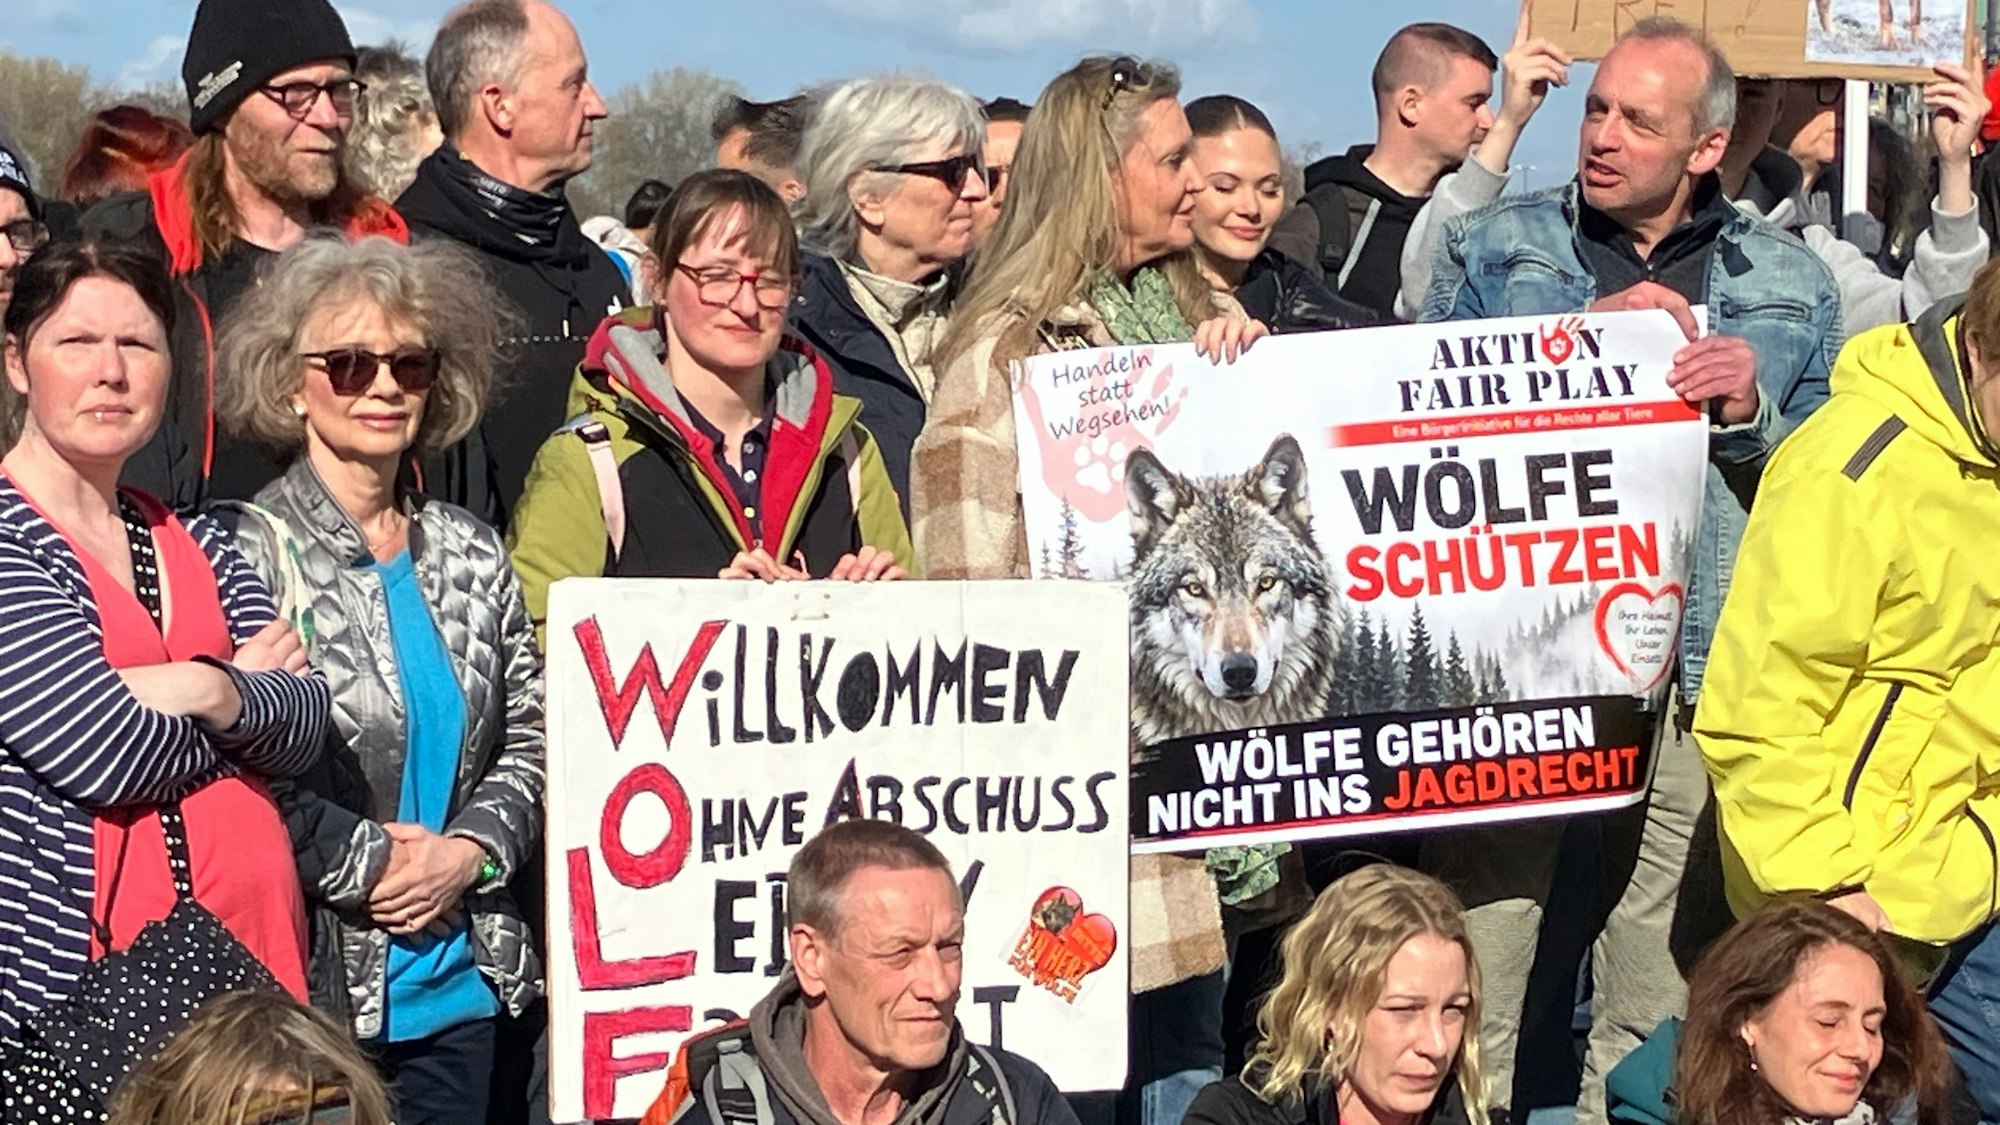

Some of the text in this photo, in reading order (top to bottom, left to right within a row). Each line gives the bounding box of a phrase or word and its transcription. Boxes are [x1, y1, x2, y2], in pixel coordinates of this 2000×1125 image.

[1052, 349, 1153, 387] Handeln
[1398, 364, 1638, 412] FAIR PLAY
[1049, 395, 1171, 440] Wegsehen!
[1078, 379, 1134, 408] statt
[1392, 424, 1418, 439] Eine
[1514, 415, 1531, 429] für
[1533, 414, 1551, 428] die
[1553, 411, 1593, 427] Rechte
[1596, 408, 1621, 424] aller
[1624, 406, 1653, 421] Tiere
[1341, 446, 1619, 536] WÖLFE
[1344, 523, 1659, 601] SCHÜTZEN
[1195, 706, 1596, 786] WÖLFE GEHÖREN
[823, 758, 1116, 834] ABSCHUSS
[1147, 746, 1640, 835] NICHT INS JAGDRECHT
[1041, 944, 1094, 990] HERZ
